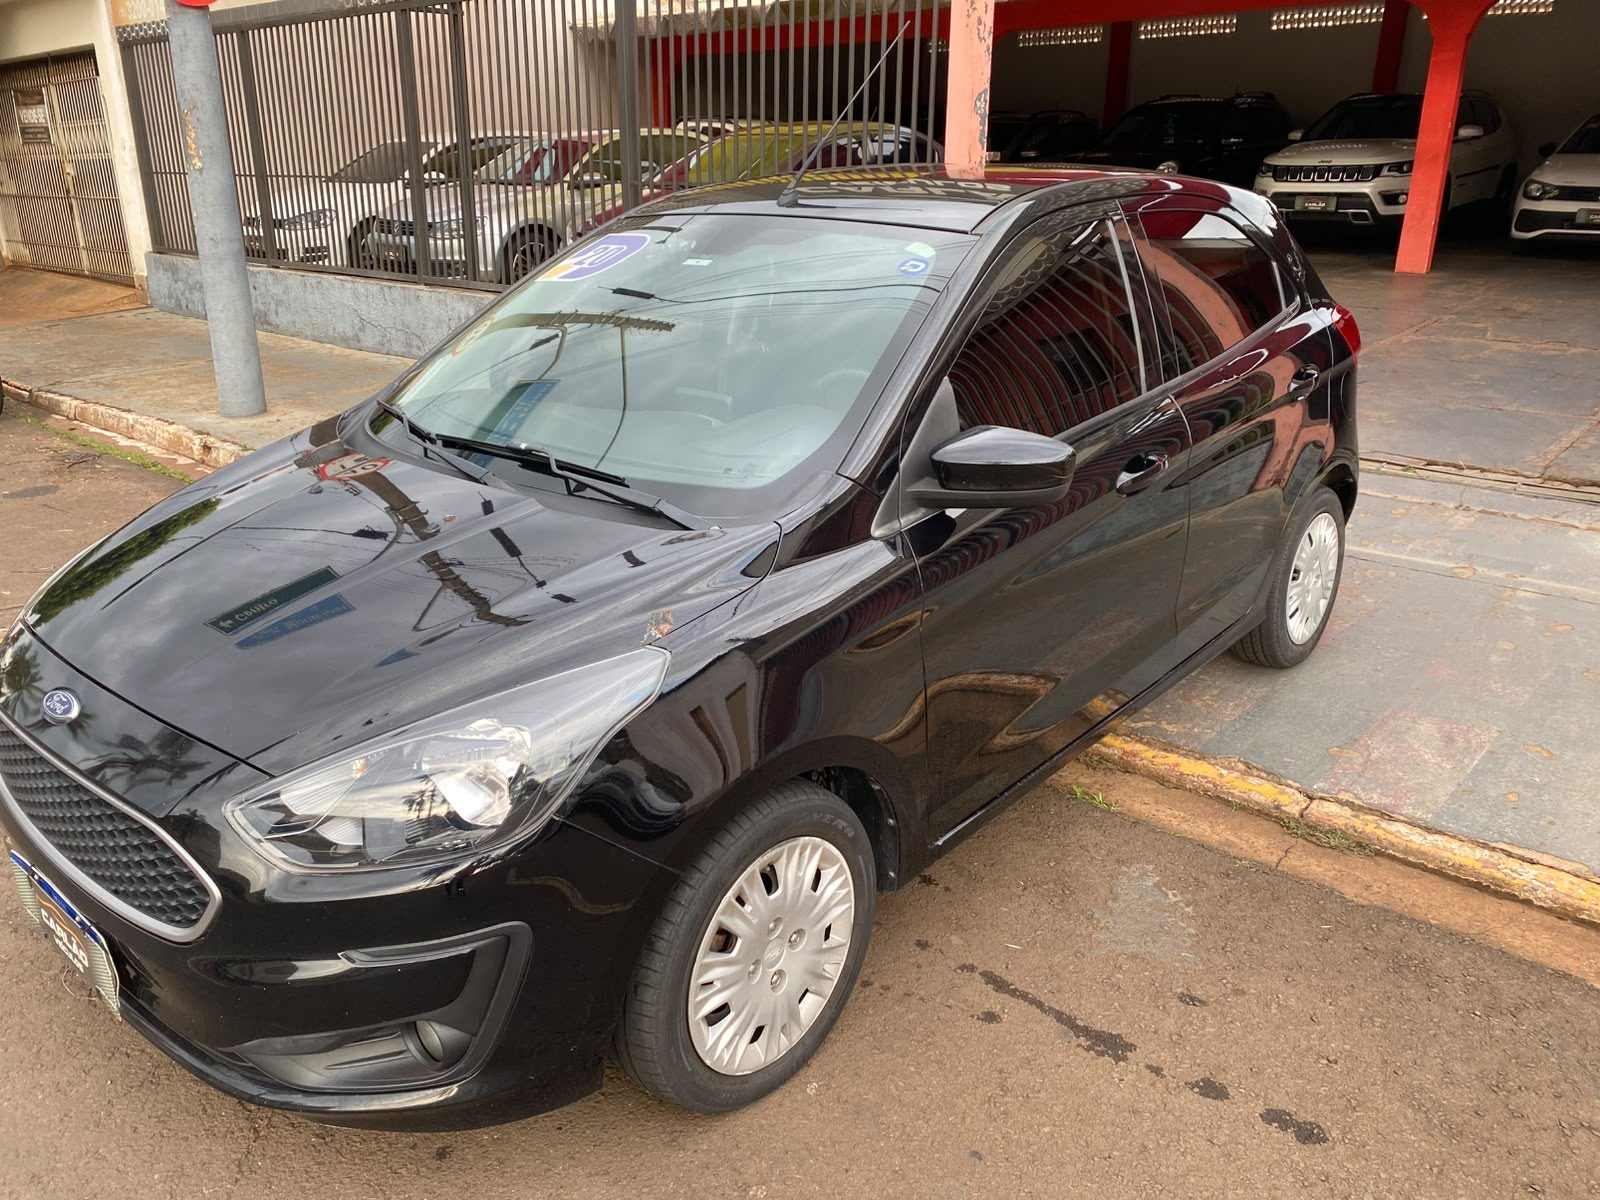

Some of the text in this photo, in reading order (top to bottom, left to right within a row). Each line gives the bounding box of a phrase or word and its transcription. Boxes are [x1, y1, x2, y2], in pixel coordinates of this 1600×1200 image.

[573, 244, 627, 267] 20
[47, 693, 69, 714] Ford
[41, 908, 88, 968] CARLÃO
